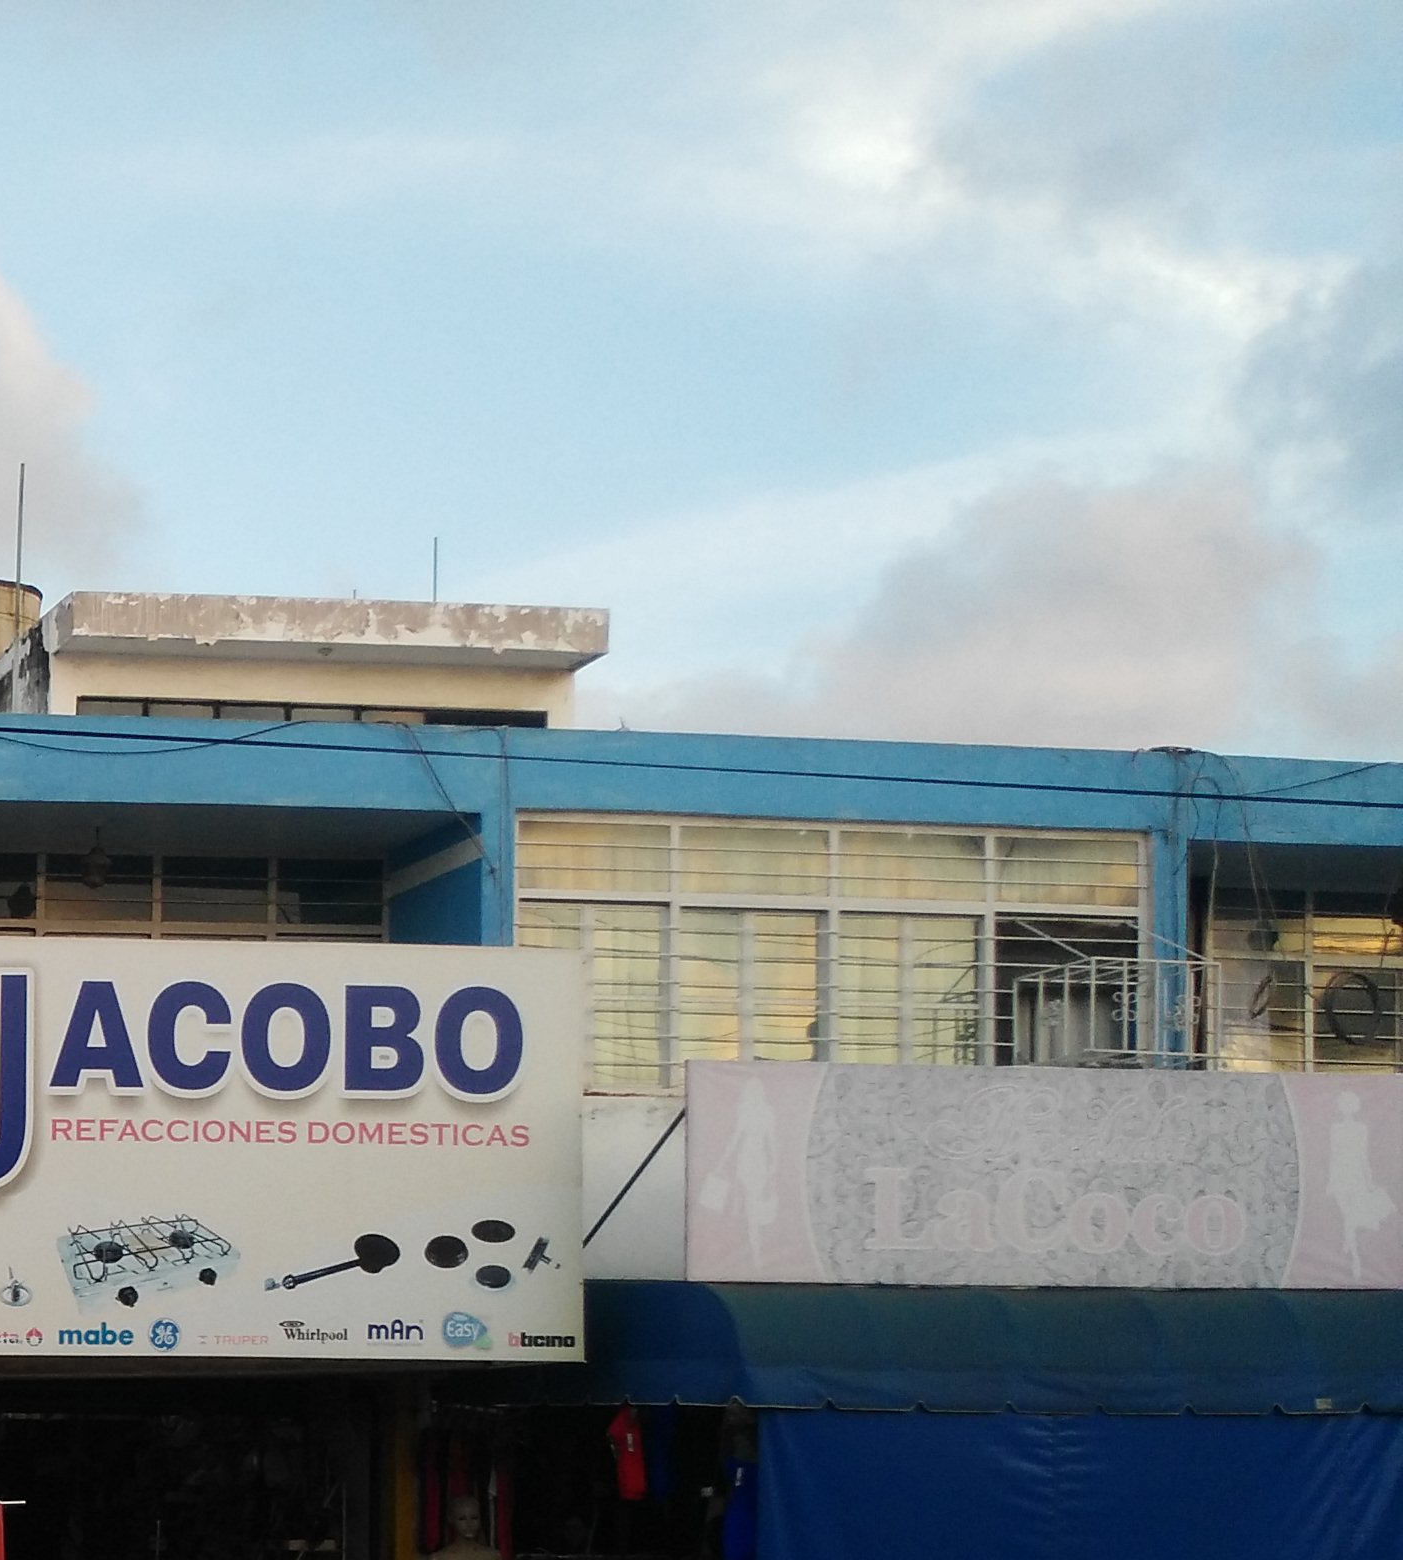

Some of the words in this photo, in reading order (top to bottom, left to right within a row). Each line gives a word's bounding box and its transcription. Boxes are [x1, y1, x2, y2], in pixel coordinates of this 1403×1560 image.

[51, 1119, 296, 1144] REFACCIONES
[308, 1121, 529, 1147] DOMESTICAS
[59, 1322, 134, 1345] mabe
[214, 1335, 268, 1345] TRUPER
[283, 1328, 348, 1344] Whirlpool
[446, 1320, 479, 1340] Easy
